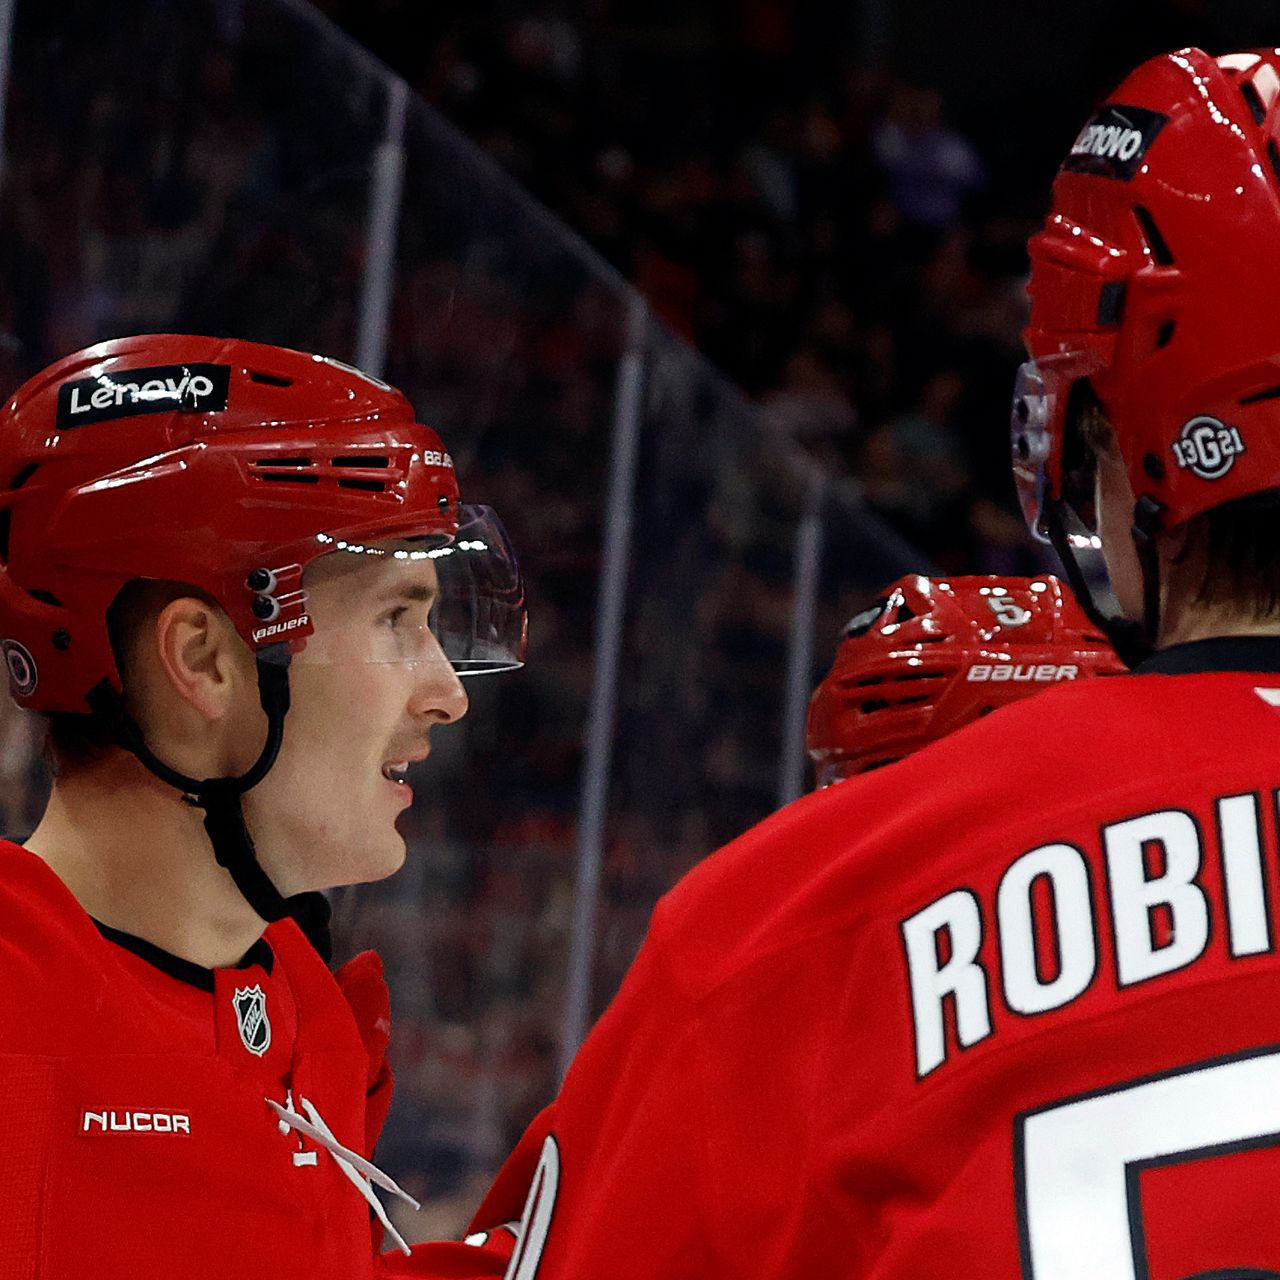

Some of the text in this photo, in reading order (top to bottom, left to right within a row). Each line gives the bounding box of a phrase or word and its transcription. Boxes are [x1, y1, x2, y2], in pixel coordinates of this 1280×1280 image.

[70, 375, 214, 414] Lenovo
[255, 616, 309, 642] BAUER
[967, 664, 1079, 681] BAUER
[83, 1111, 191, 1133] NUCOR
